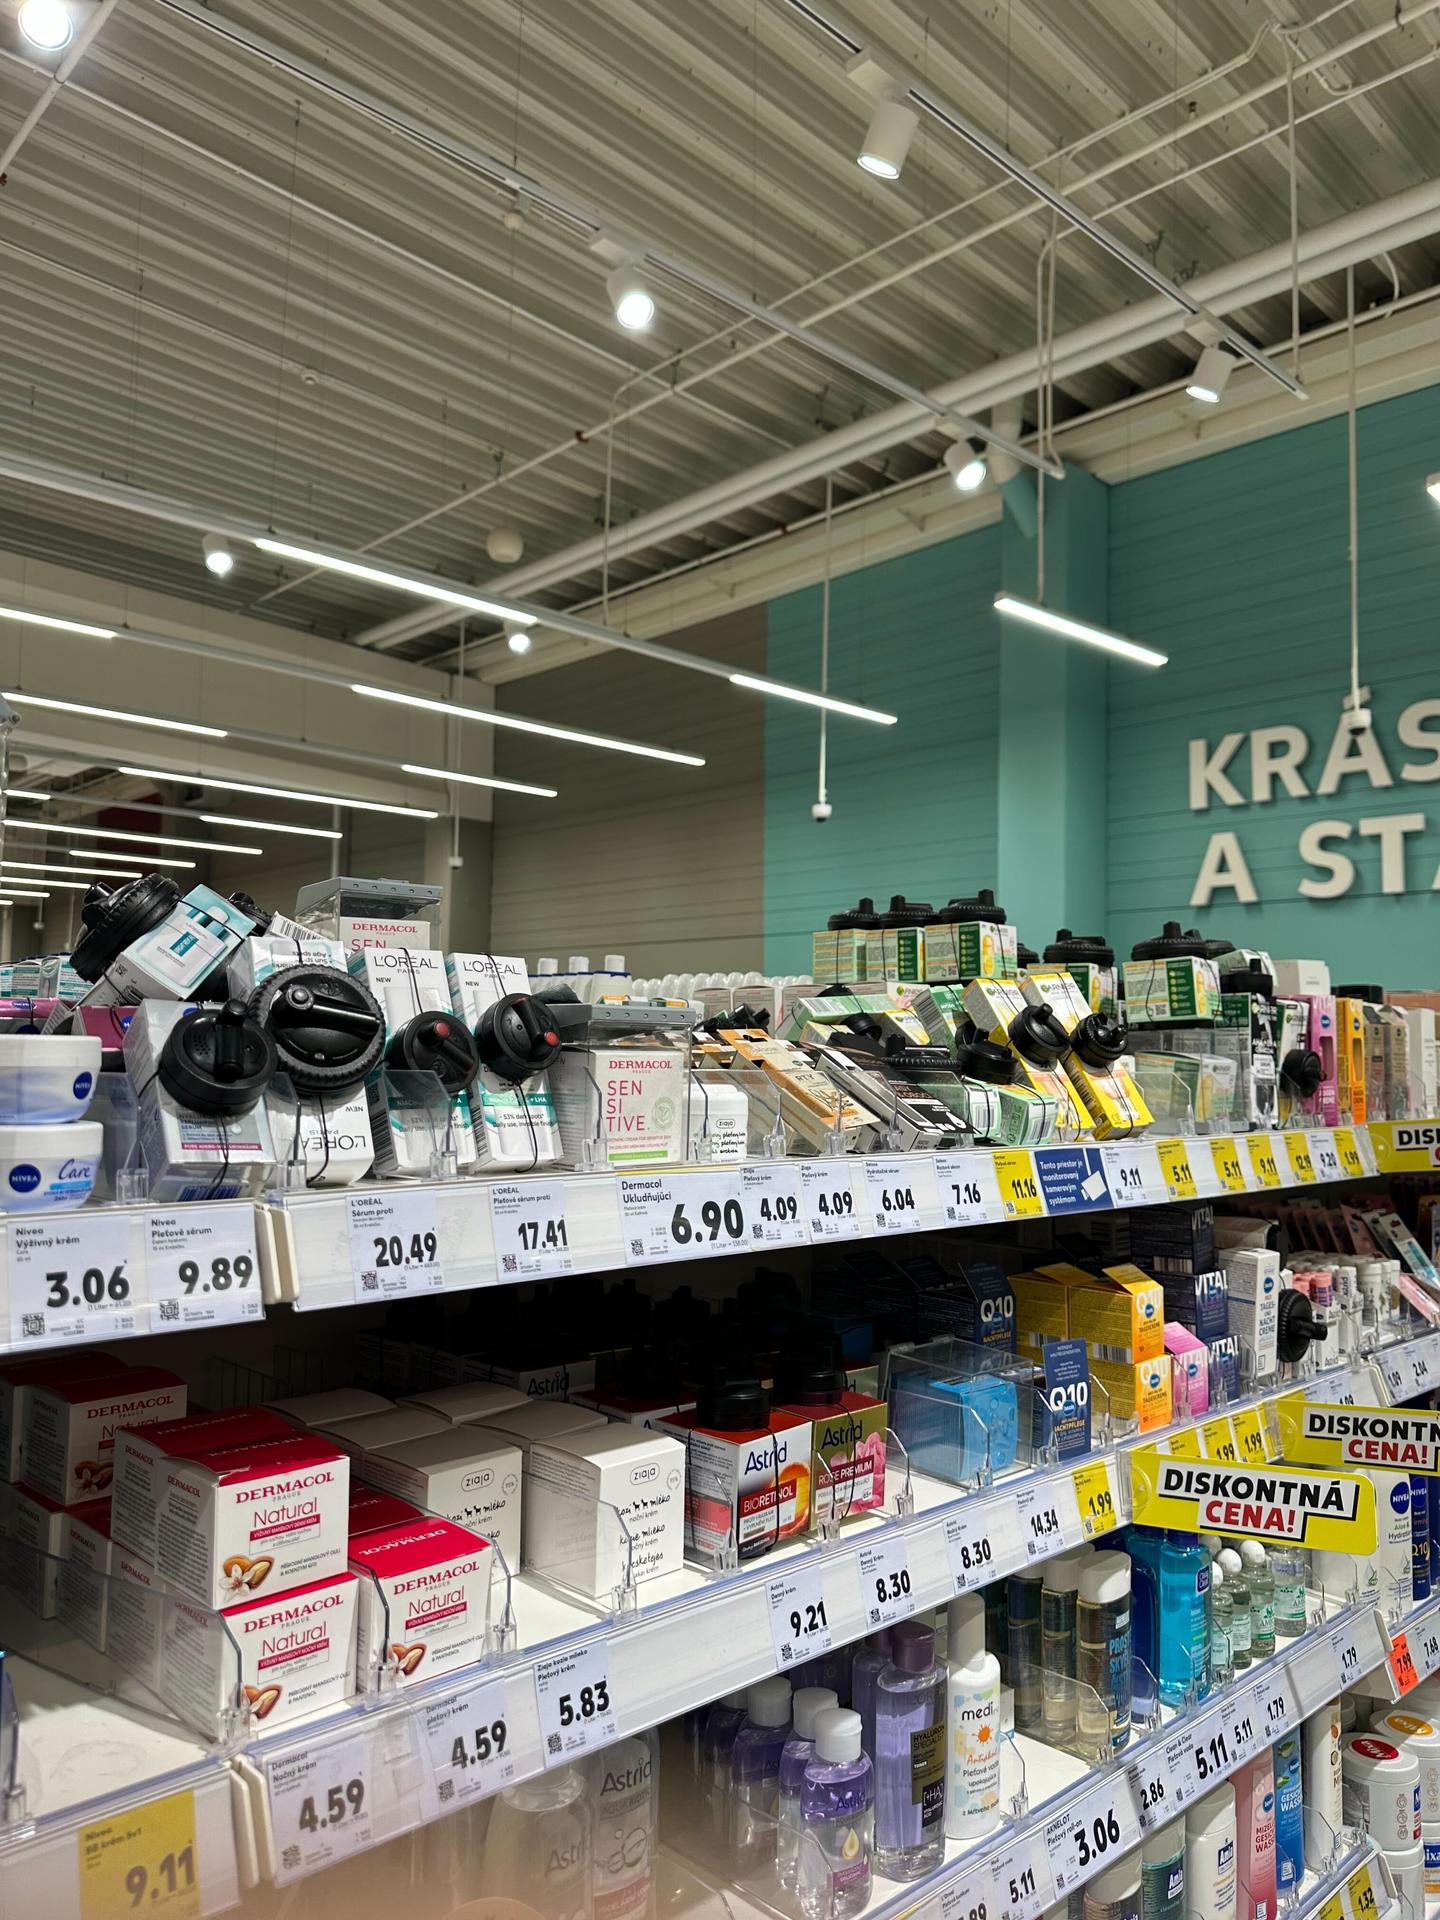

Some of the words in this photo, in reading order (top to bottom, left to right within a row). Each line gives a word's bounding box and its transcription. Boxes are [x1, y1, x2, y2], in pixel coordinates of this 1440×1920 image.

[1189, 831, 1258, 907] A
[1297, 812, 1440, 899] ST
[353, 922, 418, 933] DERMACOL
[374, 954, 439, 969] L'ORÉAL
[463, 960, 523, 976] L'ORÉAL
[609, 1060, 673, 1070] DERMACOL
[607, 1080, 643, 1096] SEN
[607, 1098, 623, 1115] SI
[606, 1115, 646, 1132] TIVE
[58, 1159, 91, 1180] Care
[1120, 1167, 1142, 1187] 9.11
[1172, 1163, 1193, 1183] 5.11
[1223, 1160, 1242, 1178] 5.11
[1259, 1157, 1278, 1174] 9.11
[12, 1174, 38, 1183] NIVEA
[621, 1178, 662, 1191] Dermacol
[1011, 1179, 1037, 1200] 11.16
[351, 1198, 383, 1207] L'ORÉAL
[492, 1187, 519, 1196] L'ORÉAL
[882, 1188, 915, 1212] 6.04
[951, 1183, 981, 1205] 7.16
[352, 1207, 376, 1217] Sérum
[377, 1207, 394, 1217] proti
[760, 1196, 798, 1222] 4.09
[819, 1191, 854, 1216] 4.09
[16, 1227, 44, 1237] Nivea
[151, 1218, 176, 1227] Nivea
[186, 1226, 213, 1236] sérum
[671, 1199, 744, 1245] 6.90
[16, 1238, 54, 1250] Výživný
[56, 1235, 80, 1246] krém
[518, 1218, 568, 1251] 17.41
[373, 1232, 437, 1268] 20.49
[178, 1254, 254, 1295] 9.89
[46, 1265, 130, 1309] 3.06
[980, 1294, 1014, 1323] Q10
[527, 1371, 569, 1396] Astrid
[87, 1394, 175, 1420] DERMACOL
[1050, 1381, 1088, 1413] Q10
[1217, 1443, 1235, 1461] 1.99
[1244, 1431, 1262, 1454] 1.99
[1348, 1438, 1428, 1465] CENA!
[745, 1440, 788, 1476] Astrd
[465, 1473, 490, 1487] ziaja
[634, 1467, 656, 1481] ziaja
[168, 1475, 201, 1498] DERMACOL
[235, 1472, 335, 1504] DERMACOL
[1163, 1468, 1345, 1512] DISKONTNÁ
[1392, 1493, 1410, 1503] NIVEA
[483, 1499, 506, 1512] mléko
[650, 1493, 671, 1506] mléko
[1088, 1490, 1112, 1518] 1.99
[254, 1496, 318, 1528] Natural
[478, 1515, 493, 1524] krém
[644, 1509, 659, 1519] krém
[1030, 1509, 1059, 1537] 14.34
[1205, 1500, 1296, 1533] CENA!
[359, 1529, 448, 1556] DERMACOL
[641, 1523, 666, 1539] mlieko
[644, 1537, 659, 1547] krém
[961, 1538, 992, 1569] 8.30
[393, 1561, 480, 1596] DERMACOL
[876, 1569, 911, 1603] 8.30
[408, 1585, 465, 1617] Natural
[244, 1595, 344, 1633] DERMACOL
[790, 1600, 827, 1639] 9.21
[262, 1620, 327, 1657] Natural
[1423, 1636, 1439, 1658] 7.68
[553, 1656, 568, 1666] kozie
[560, 1663, 576, 1673] krém
[1341, 1646, 1357, 1669] 1.79
[1396, 1653, 1412, 1674] 7.99
[452, 1703, 469, 1715] krém
[559, 1680, 610, 1727] 5.83
[1267, 1696, 1285, 1721] 1.79
[1234, 1717, 1254, 1745] 5.11
[451, 1720, 507, 1769] 4.59
[297, 1761, 317, 1773] krém
[1195, 1733, 1229, 1780] 5.11
[299, 1778, 364, 1833] 4.59
[1140, 1777, 1165, 1811] 2.86
[1046, 1814, 1071, 1836] AKNELOT
[1066, 1819, 1083, 1837] roll-on
[1073, 1809, 1120, 1867] 3.06
[125, 1845, 197, 1909] 9.11
[1009, 1868, 1036, 1904] 5.11
[1358, 1887, 1375, 1912] 1.32
